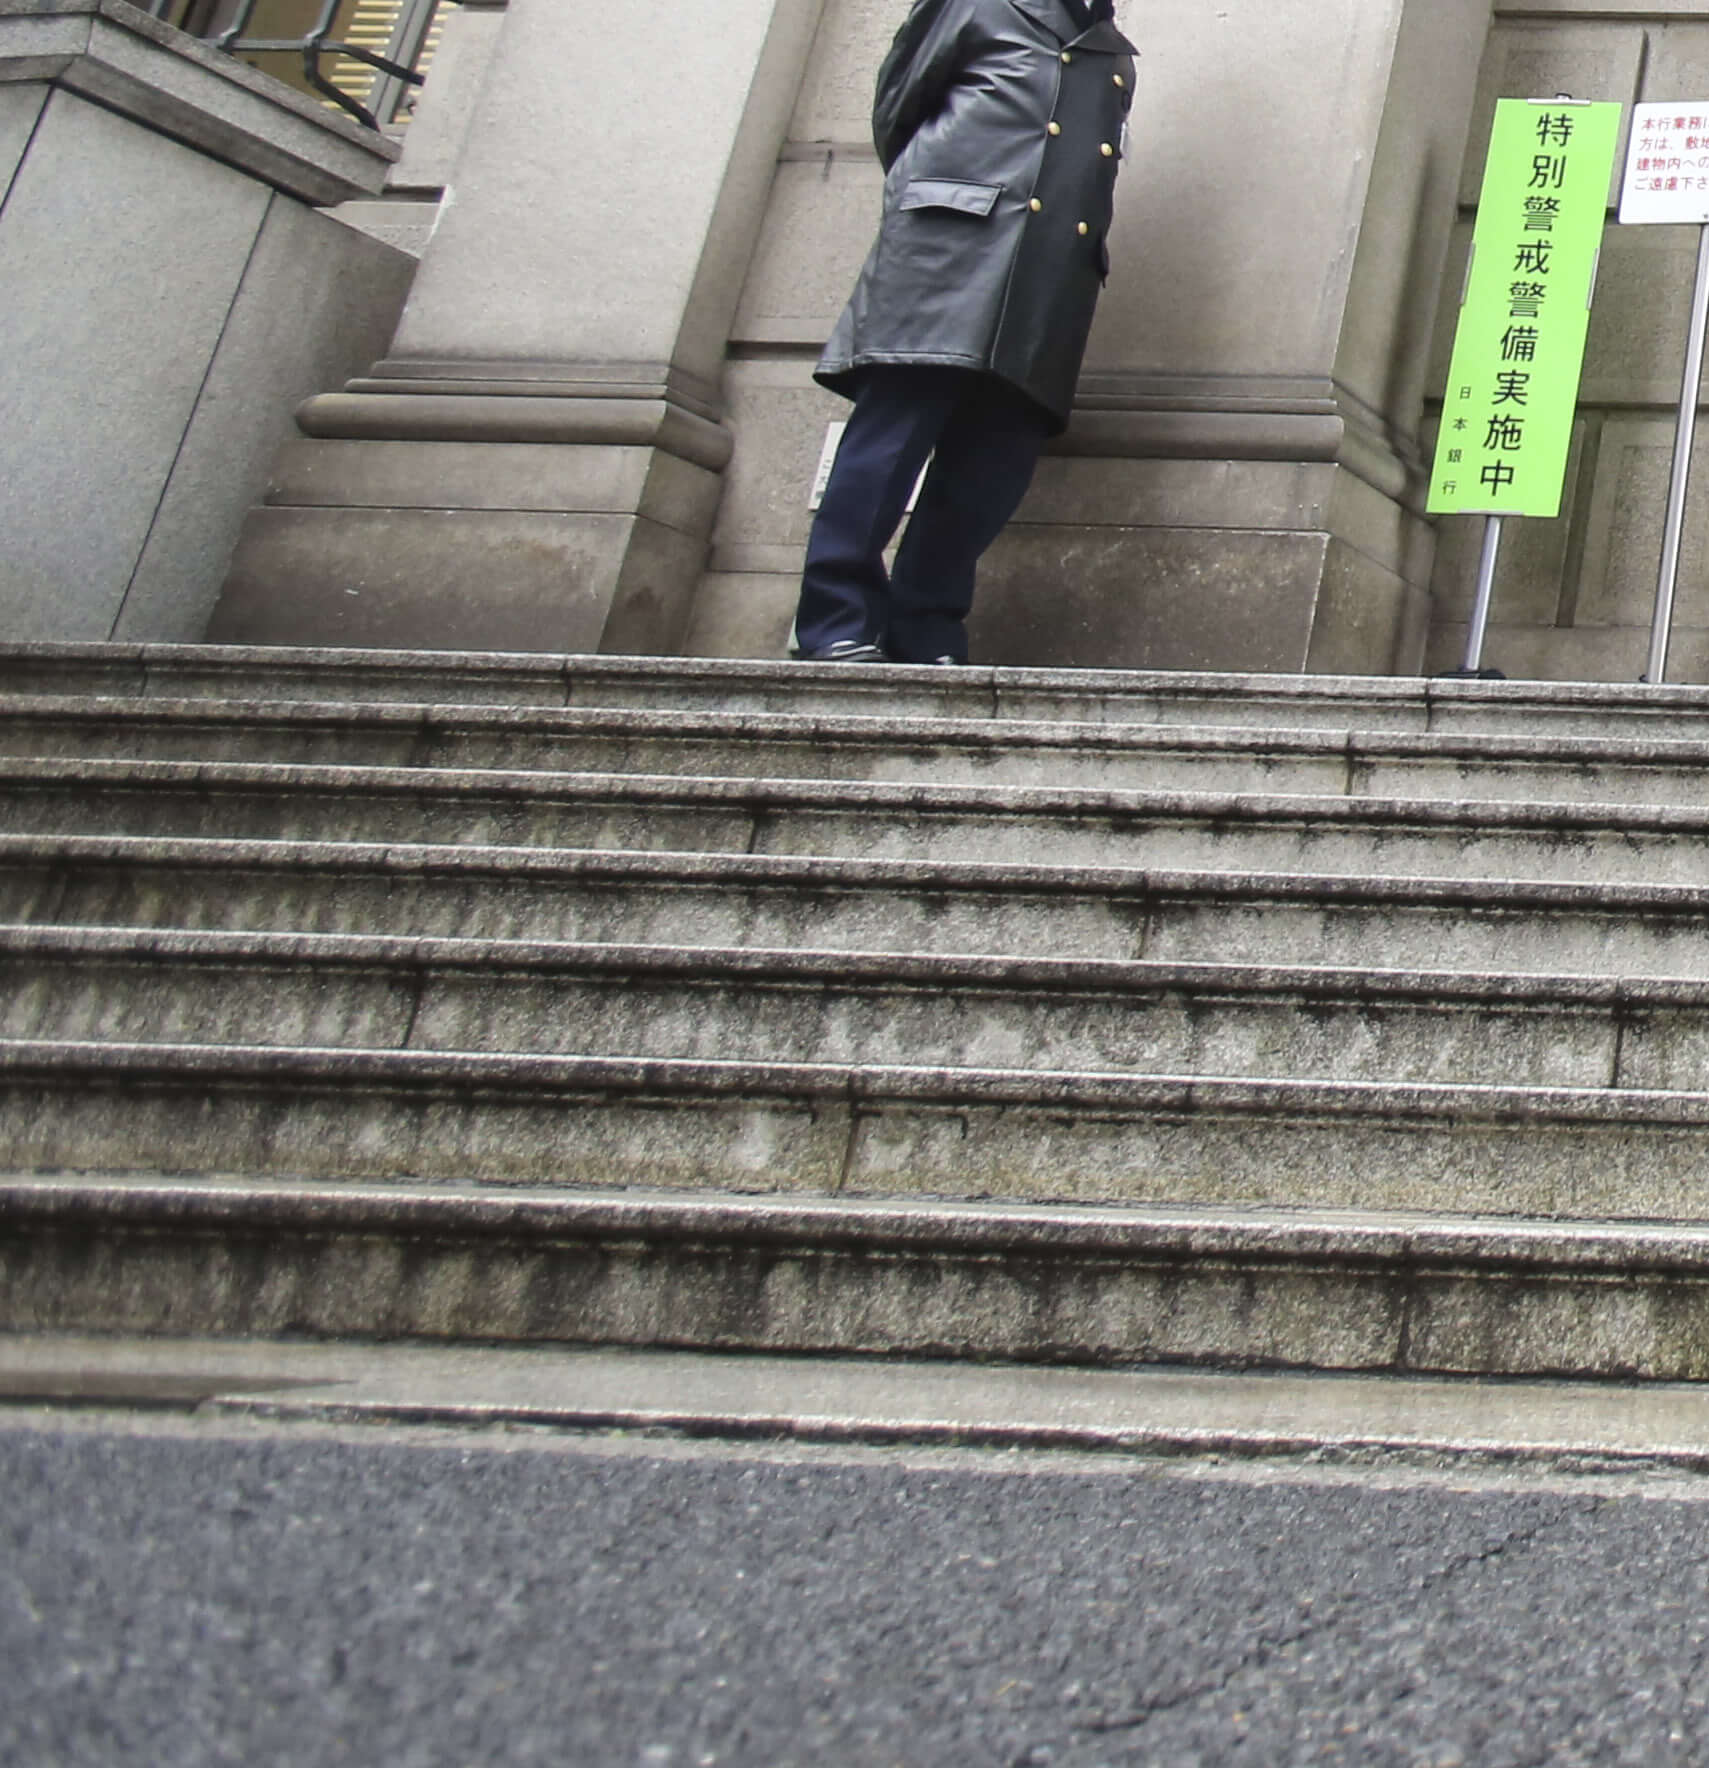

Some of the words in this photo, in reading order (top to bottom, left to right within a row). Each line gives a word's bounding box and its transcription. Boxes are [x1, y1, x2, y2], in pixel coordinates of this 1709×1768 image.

[1480, 112, 1574, 497] 特別警戒警備実施中
[1442, 386, 1471, 495] 日本銀行
